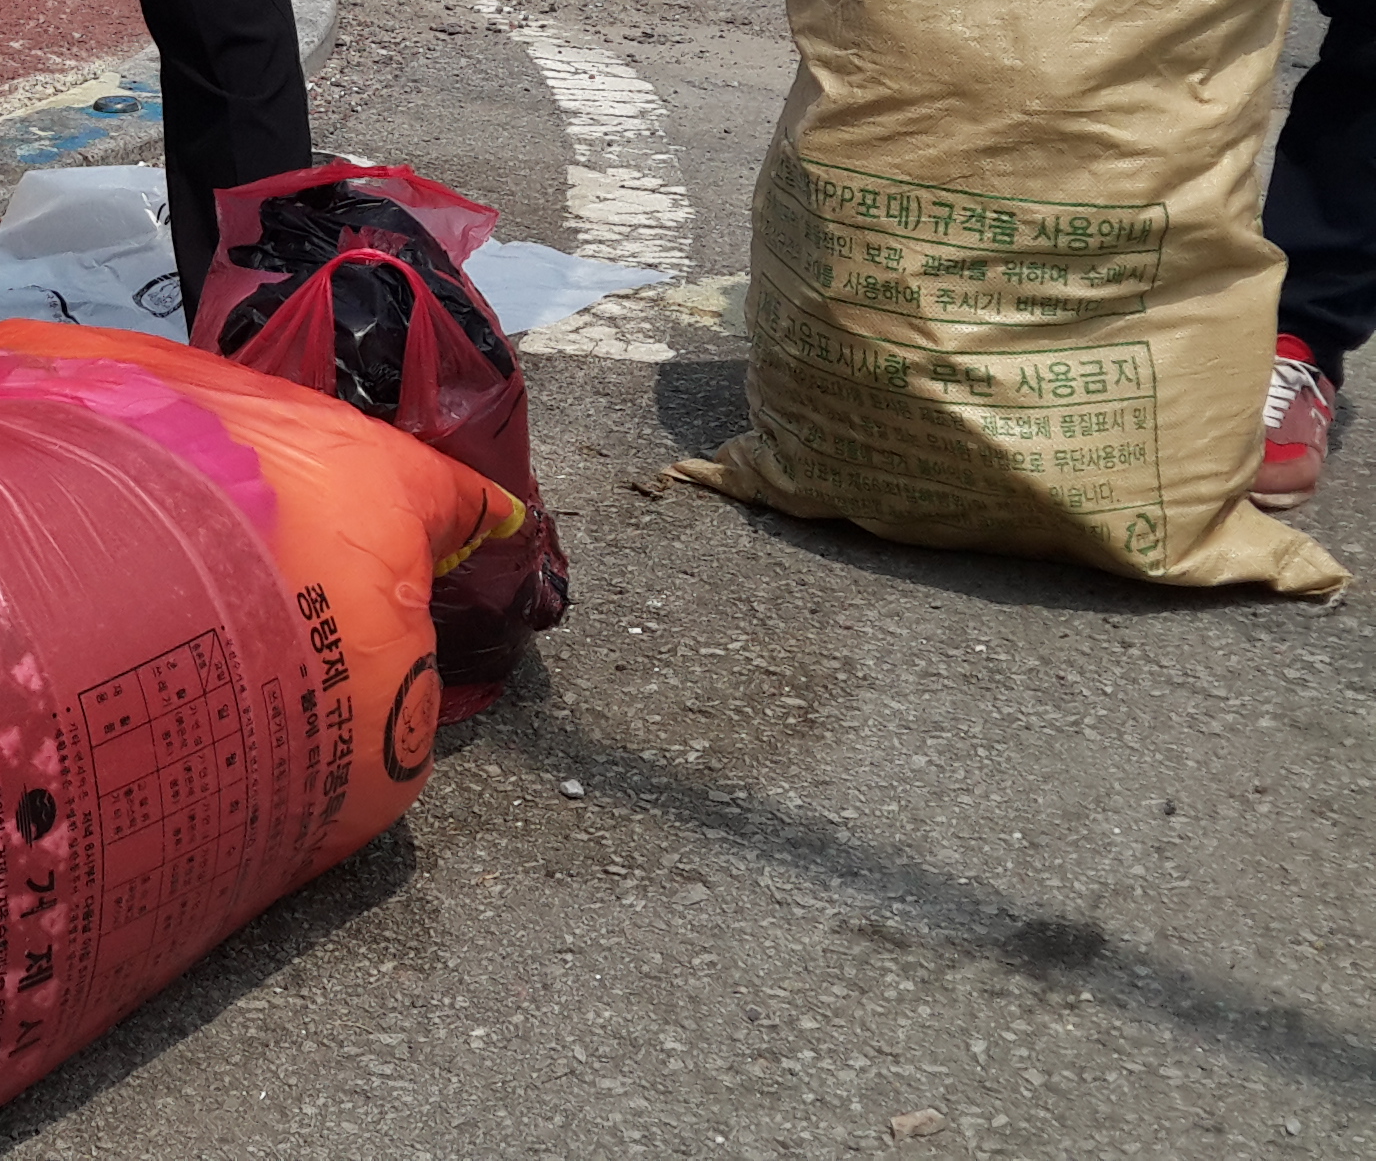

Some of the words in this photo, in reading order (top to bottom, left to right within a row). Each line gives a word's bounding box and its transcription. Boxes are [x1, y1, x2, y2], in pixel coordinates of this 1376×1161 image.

[1031, 216, 1153, 251] 사용안내
[844, 270, 922, 310] 사용하여
[935, 288, 1002, 314] 주시기
[1002, 259, 1068, 286] 위하여
[930, 363, 994, 398] 무단
[1014, 355, 1141, 400] 사용금지
[1059, 409, 1125, 439] 품질표시
[1132, 406, 1148, 431] 및
[297, 583, 349, 692] 종량제
